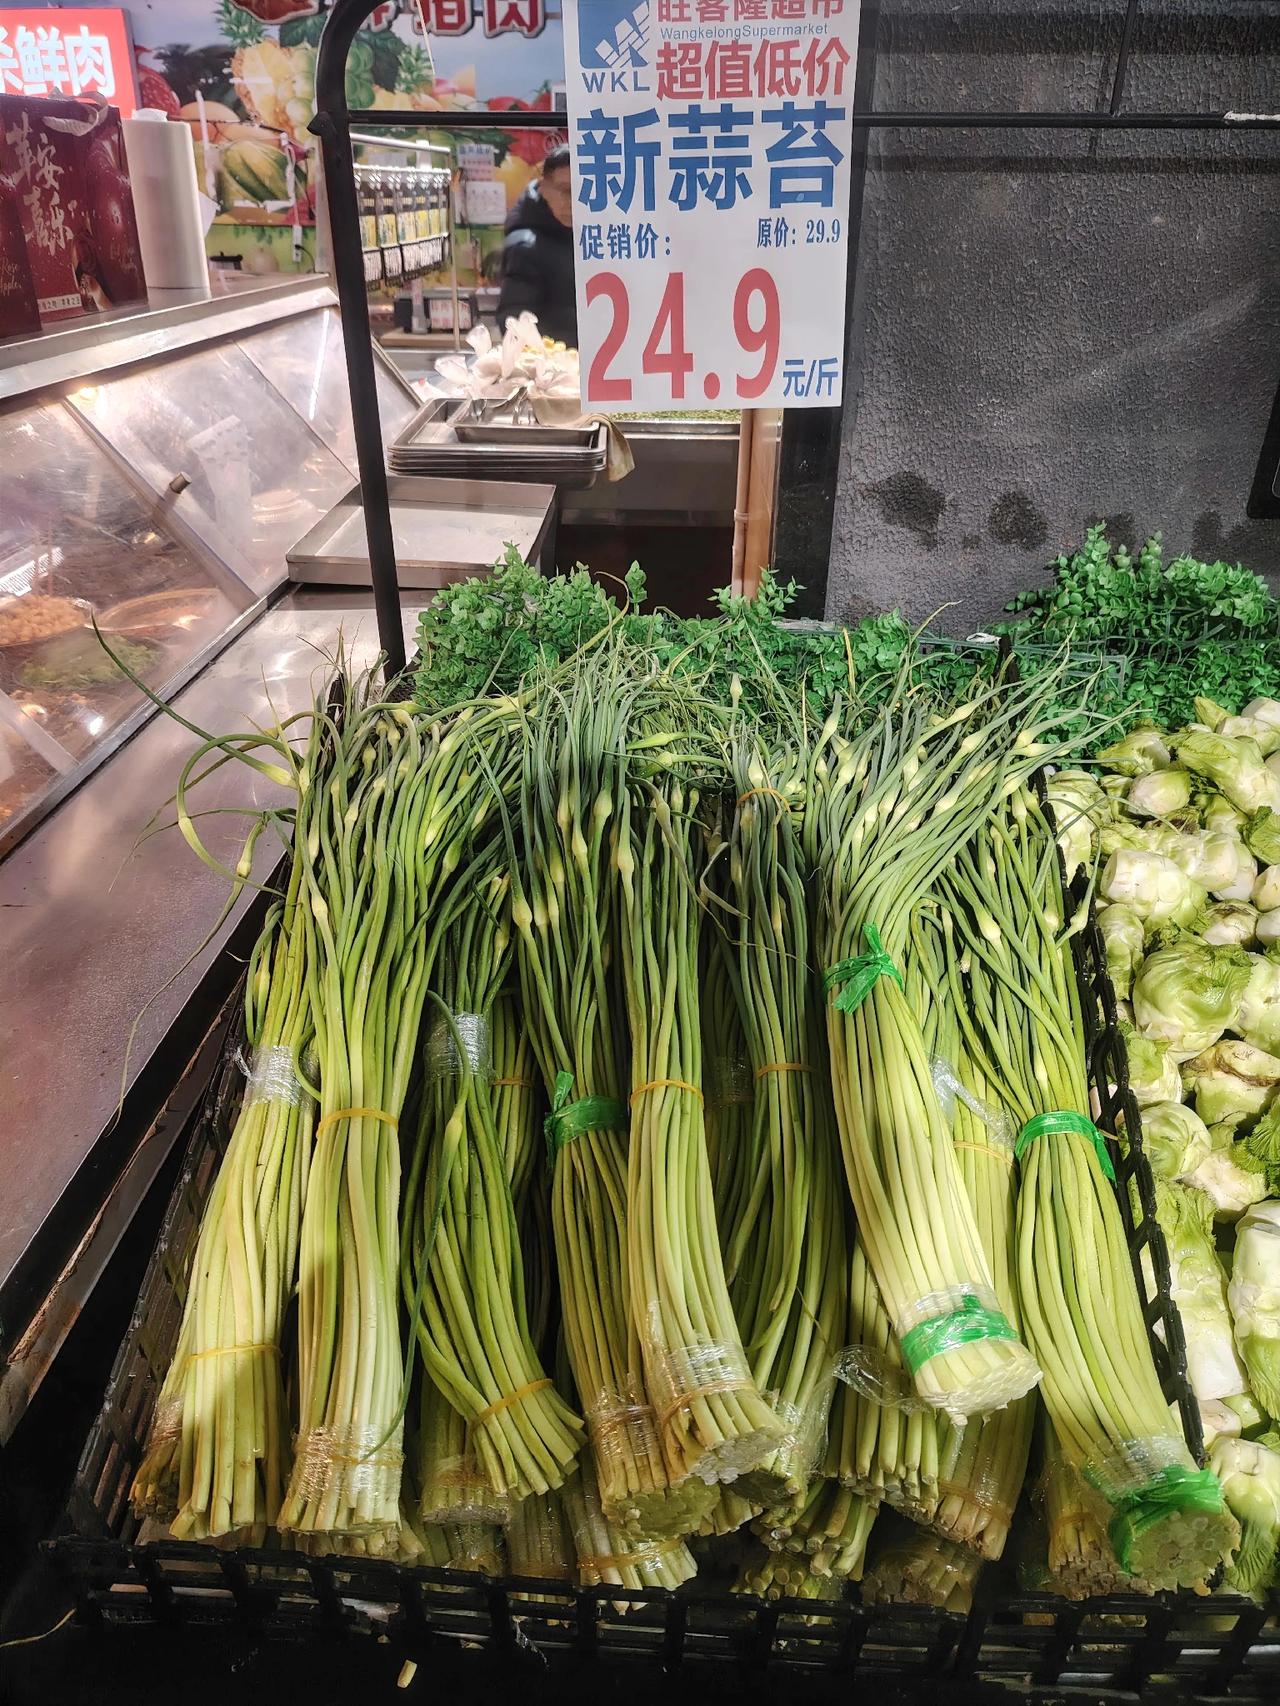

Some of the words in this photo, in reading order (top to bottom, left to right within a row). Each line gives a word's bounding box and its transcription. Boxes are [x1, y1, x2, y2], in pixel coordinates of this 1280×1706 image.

[660, 23, 828, 41] WangkelongSupermarket
[582, 71, 650, 93] WKL
[656, 37, 850, 101] 超值低价
[576, 100, 846, 214] 新蒜苔
[585, 268, 781, 402] 24.9
[782, 357, 839, 398] 元/斤
